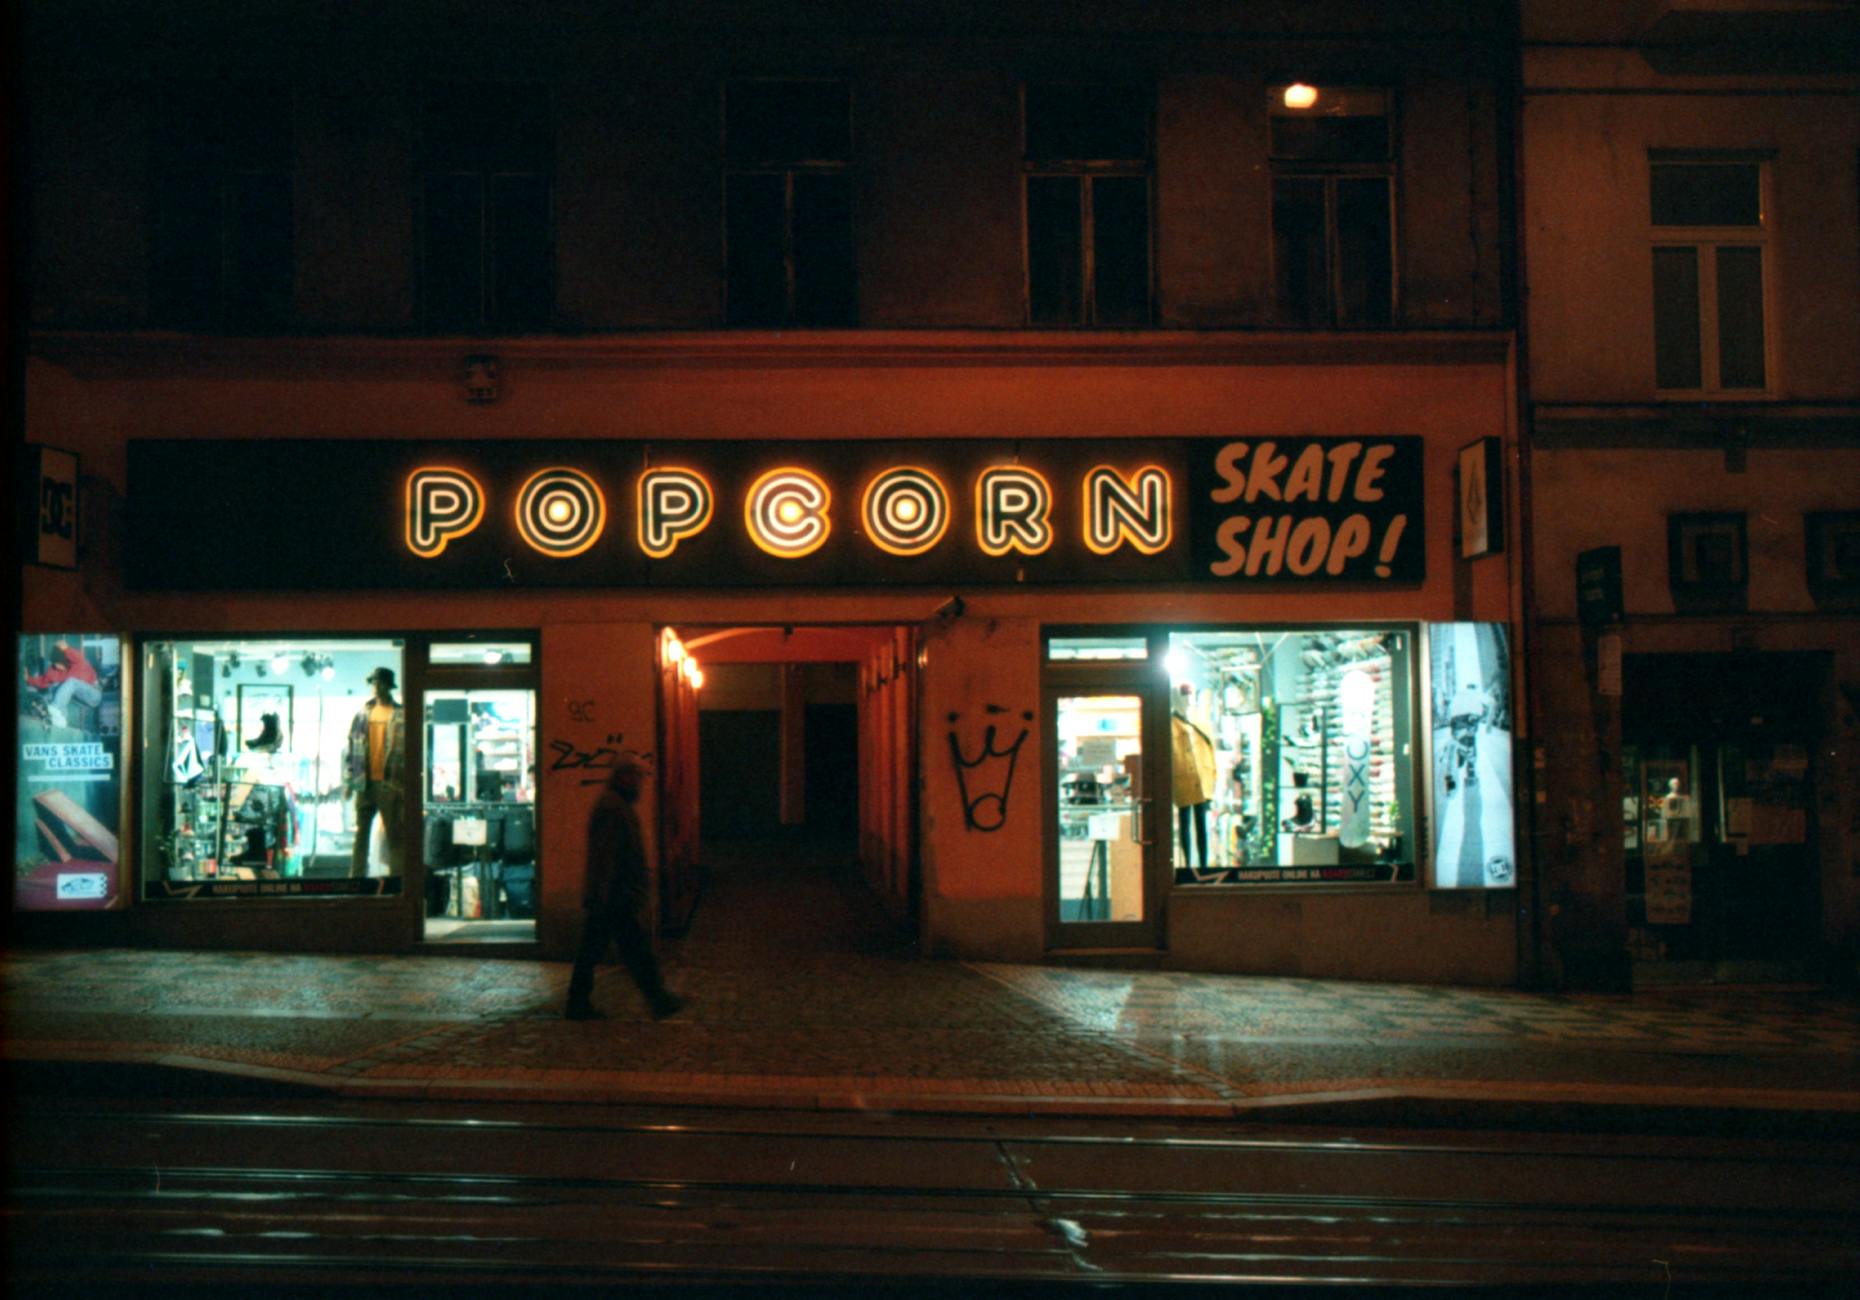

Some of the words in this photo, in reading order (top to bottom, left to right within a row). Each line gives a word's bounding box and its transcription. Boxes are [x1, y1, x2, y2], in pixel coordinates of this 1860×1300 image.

[1210, 441, 1396, 503] SKATE
[405, 465, 1173, 559] POPCORN
[1210, 513, 1408, 578] SHOP!
[25, 745, 58, 757] VANS
[63, 744, 101, 756] SKATE
[48, 756, 110, 768] CLASSICS
